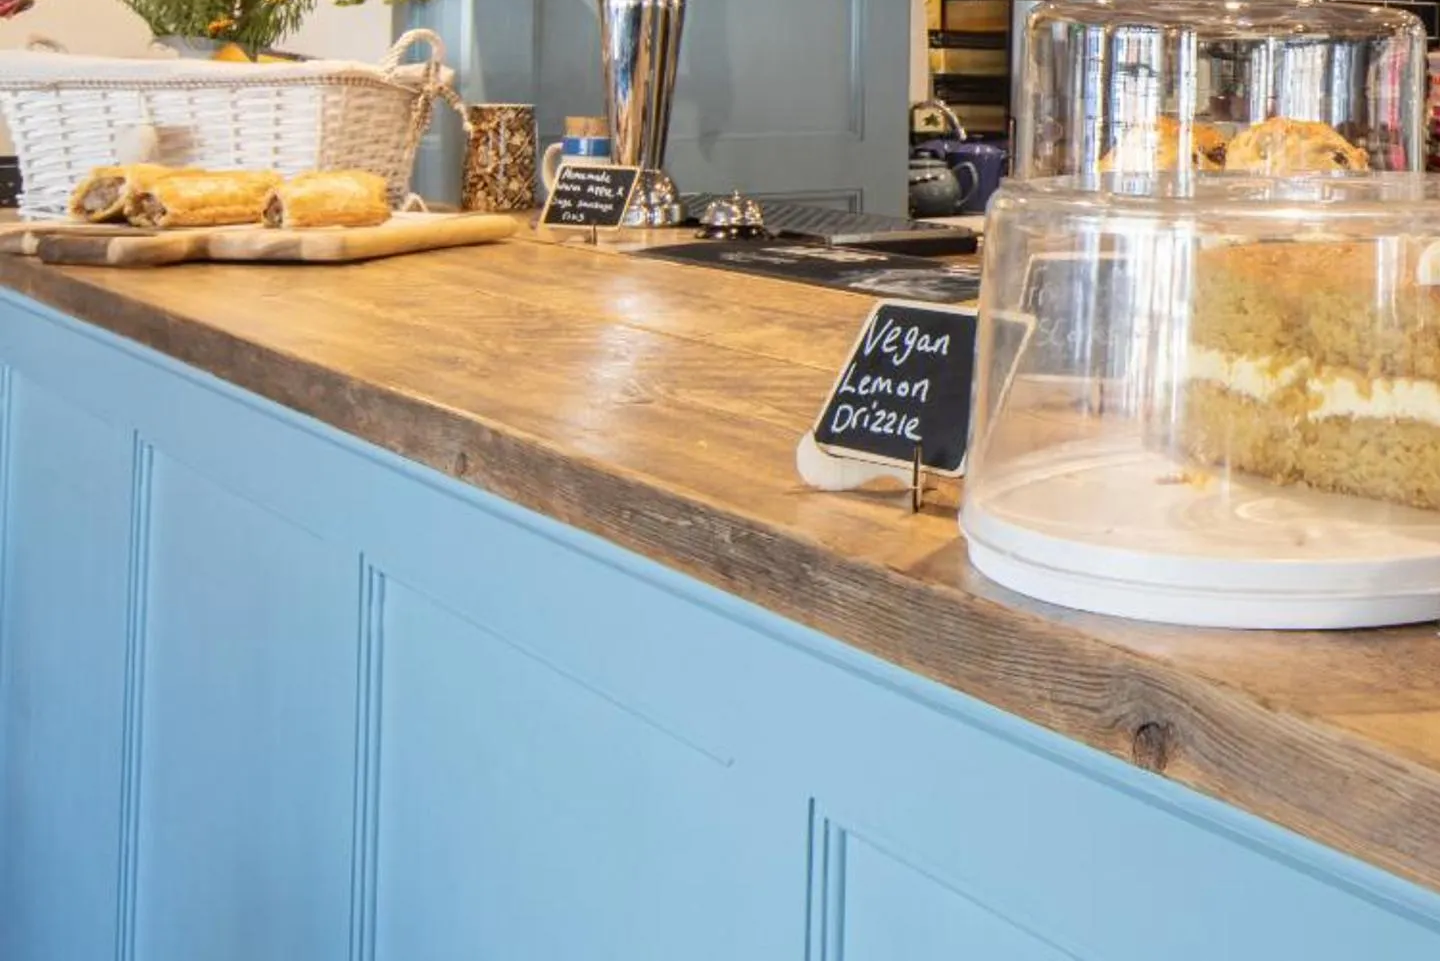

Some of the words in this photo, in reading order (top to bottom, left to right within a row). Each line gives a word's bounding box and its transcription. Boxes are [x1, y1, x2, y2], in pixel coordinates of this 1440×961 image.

[863, 315, 950, 366] Vegan
[838, 361, 930, 403] Lemon
[830, 401, 923, 441] Drizzle
